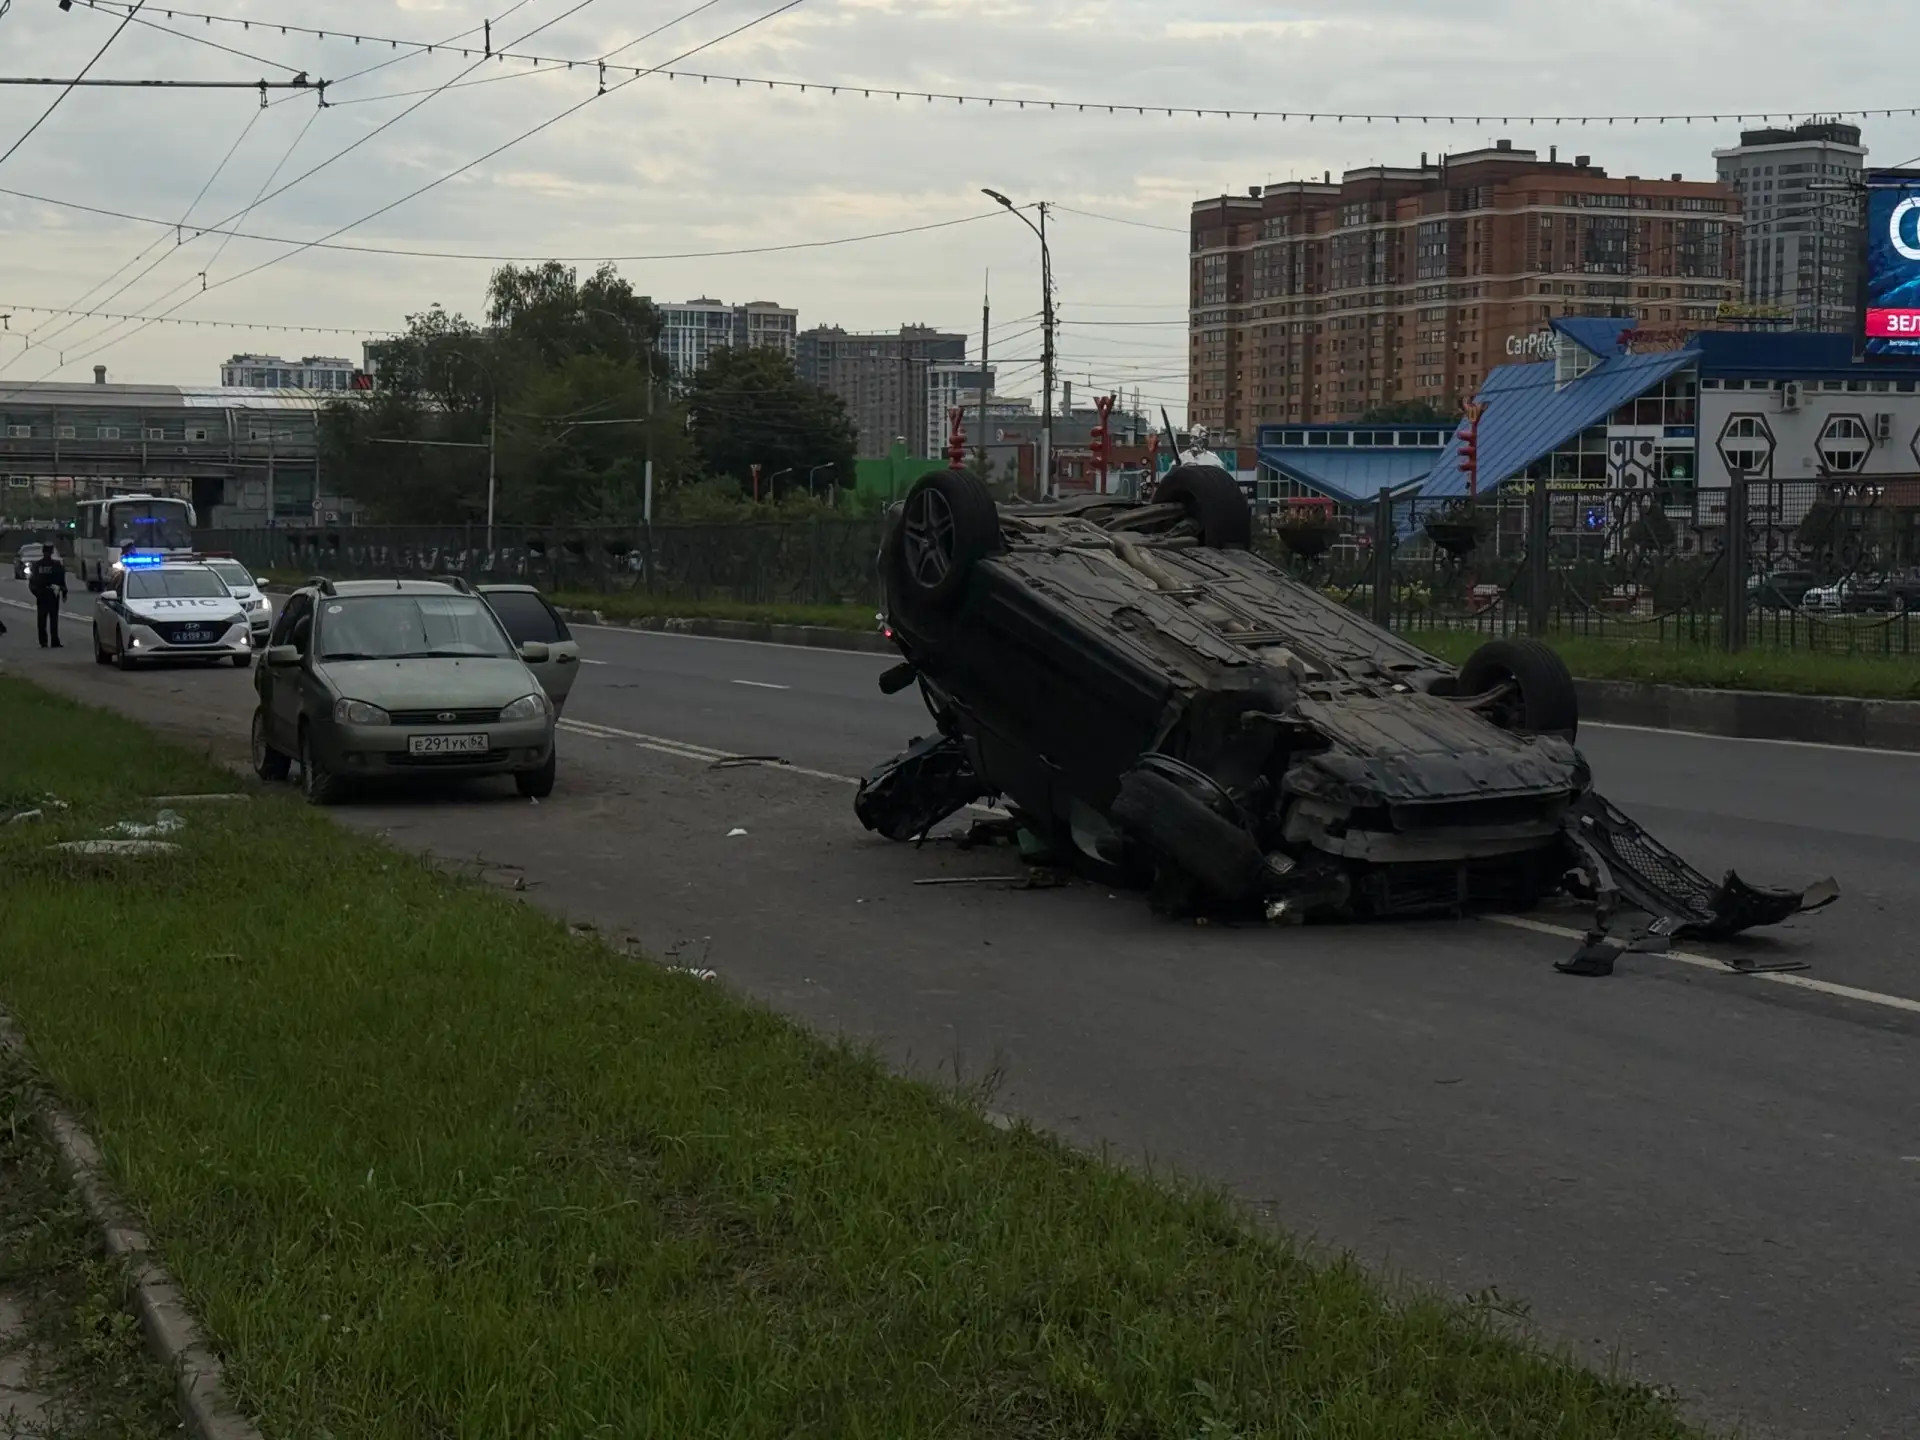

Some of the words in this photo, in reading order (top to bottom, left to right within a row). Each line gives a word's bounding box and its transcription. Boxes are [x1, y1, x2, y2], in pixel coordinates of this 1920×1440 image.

[1505, 330, 1555, 355] CarPric
[153, 599, 218, 610] ДПС
[415, 737, 467, 751] Е291УК
[470, 735, 484, 747] 62
